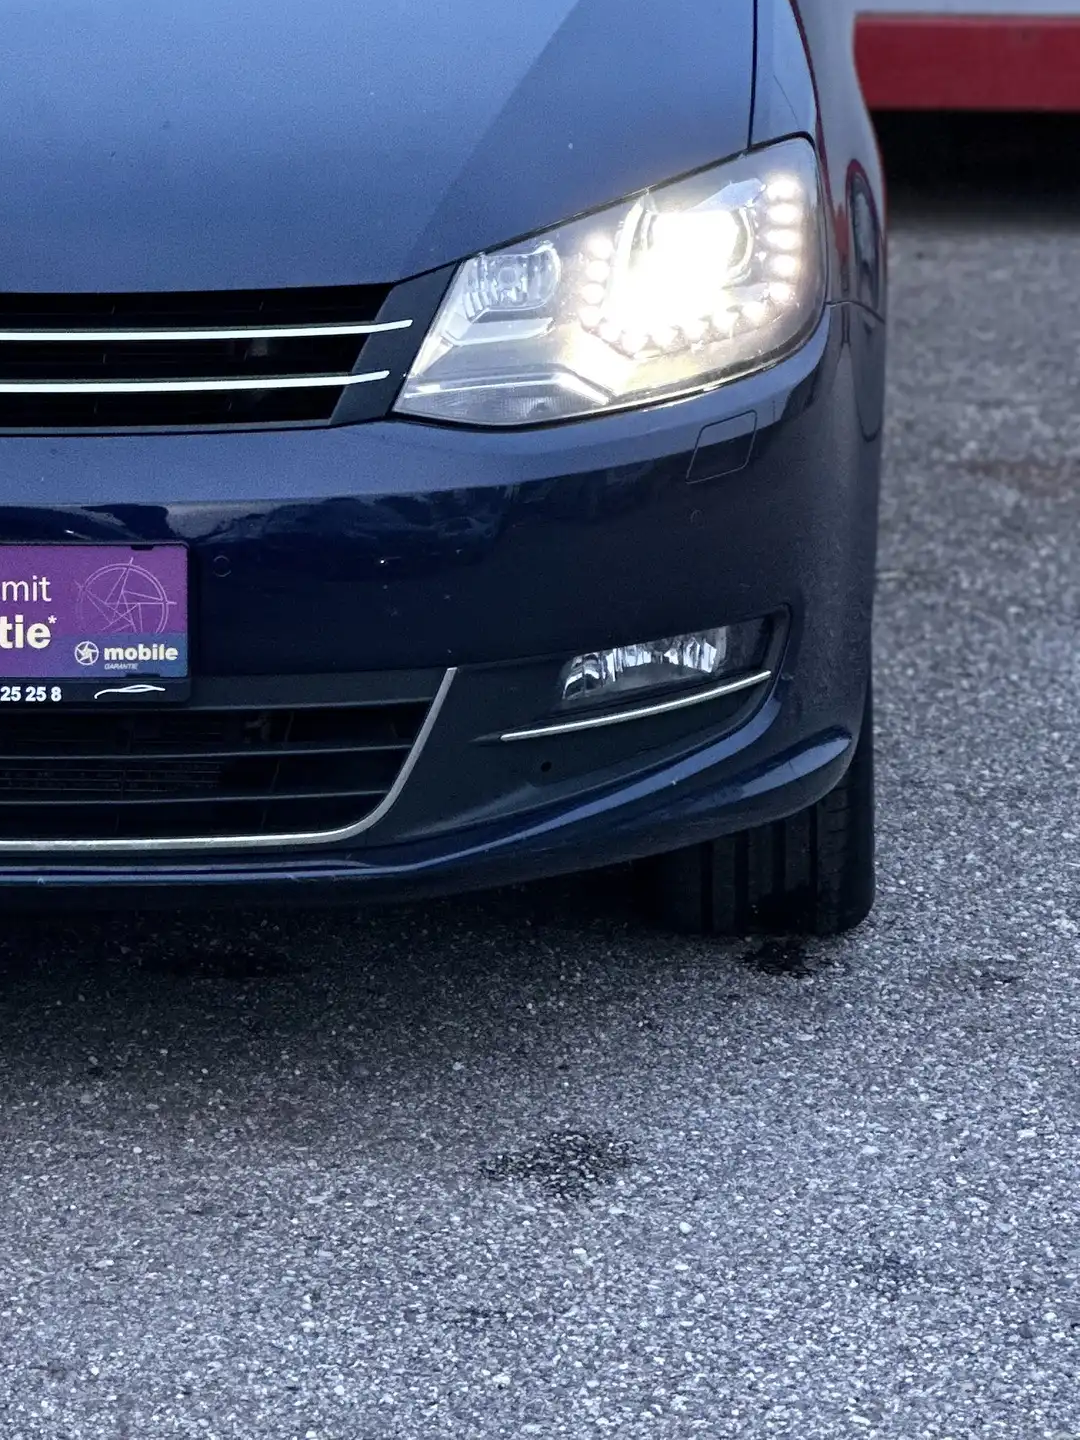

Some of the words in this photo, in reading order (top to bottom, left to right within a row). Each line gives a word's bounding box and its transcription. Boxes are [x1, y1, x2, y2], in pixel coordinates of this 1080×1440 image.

[1, 575, 52, 602] mit
[104, 644, 179, 661] mobile
[0, 686, 21, 702] 25
[25, 686, 47, 702] 25
[50, 687, 62, 702] 8
